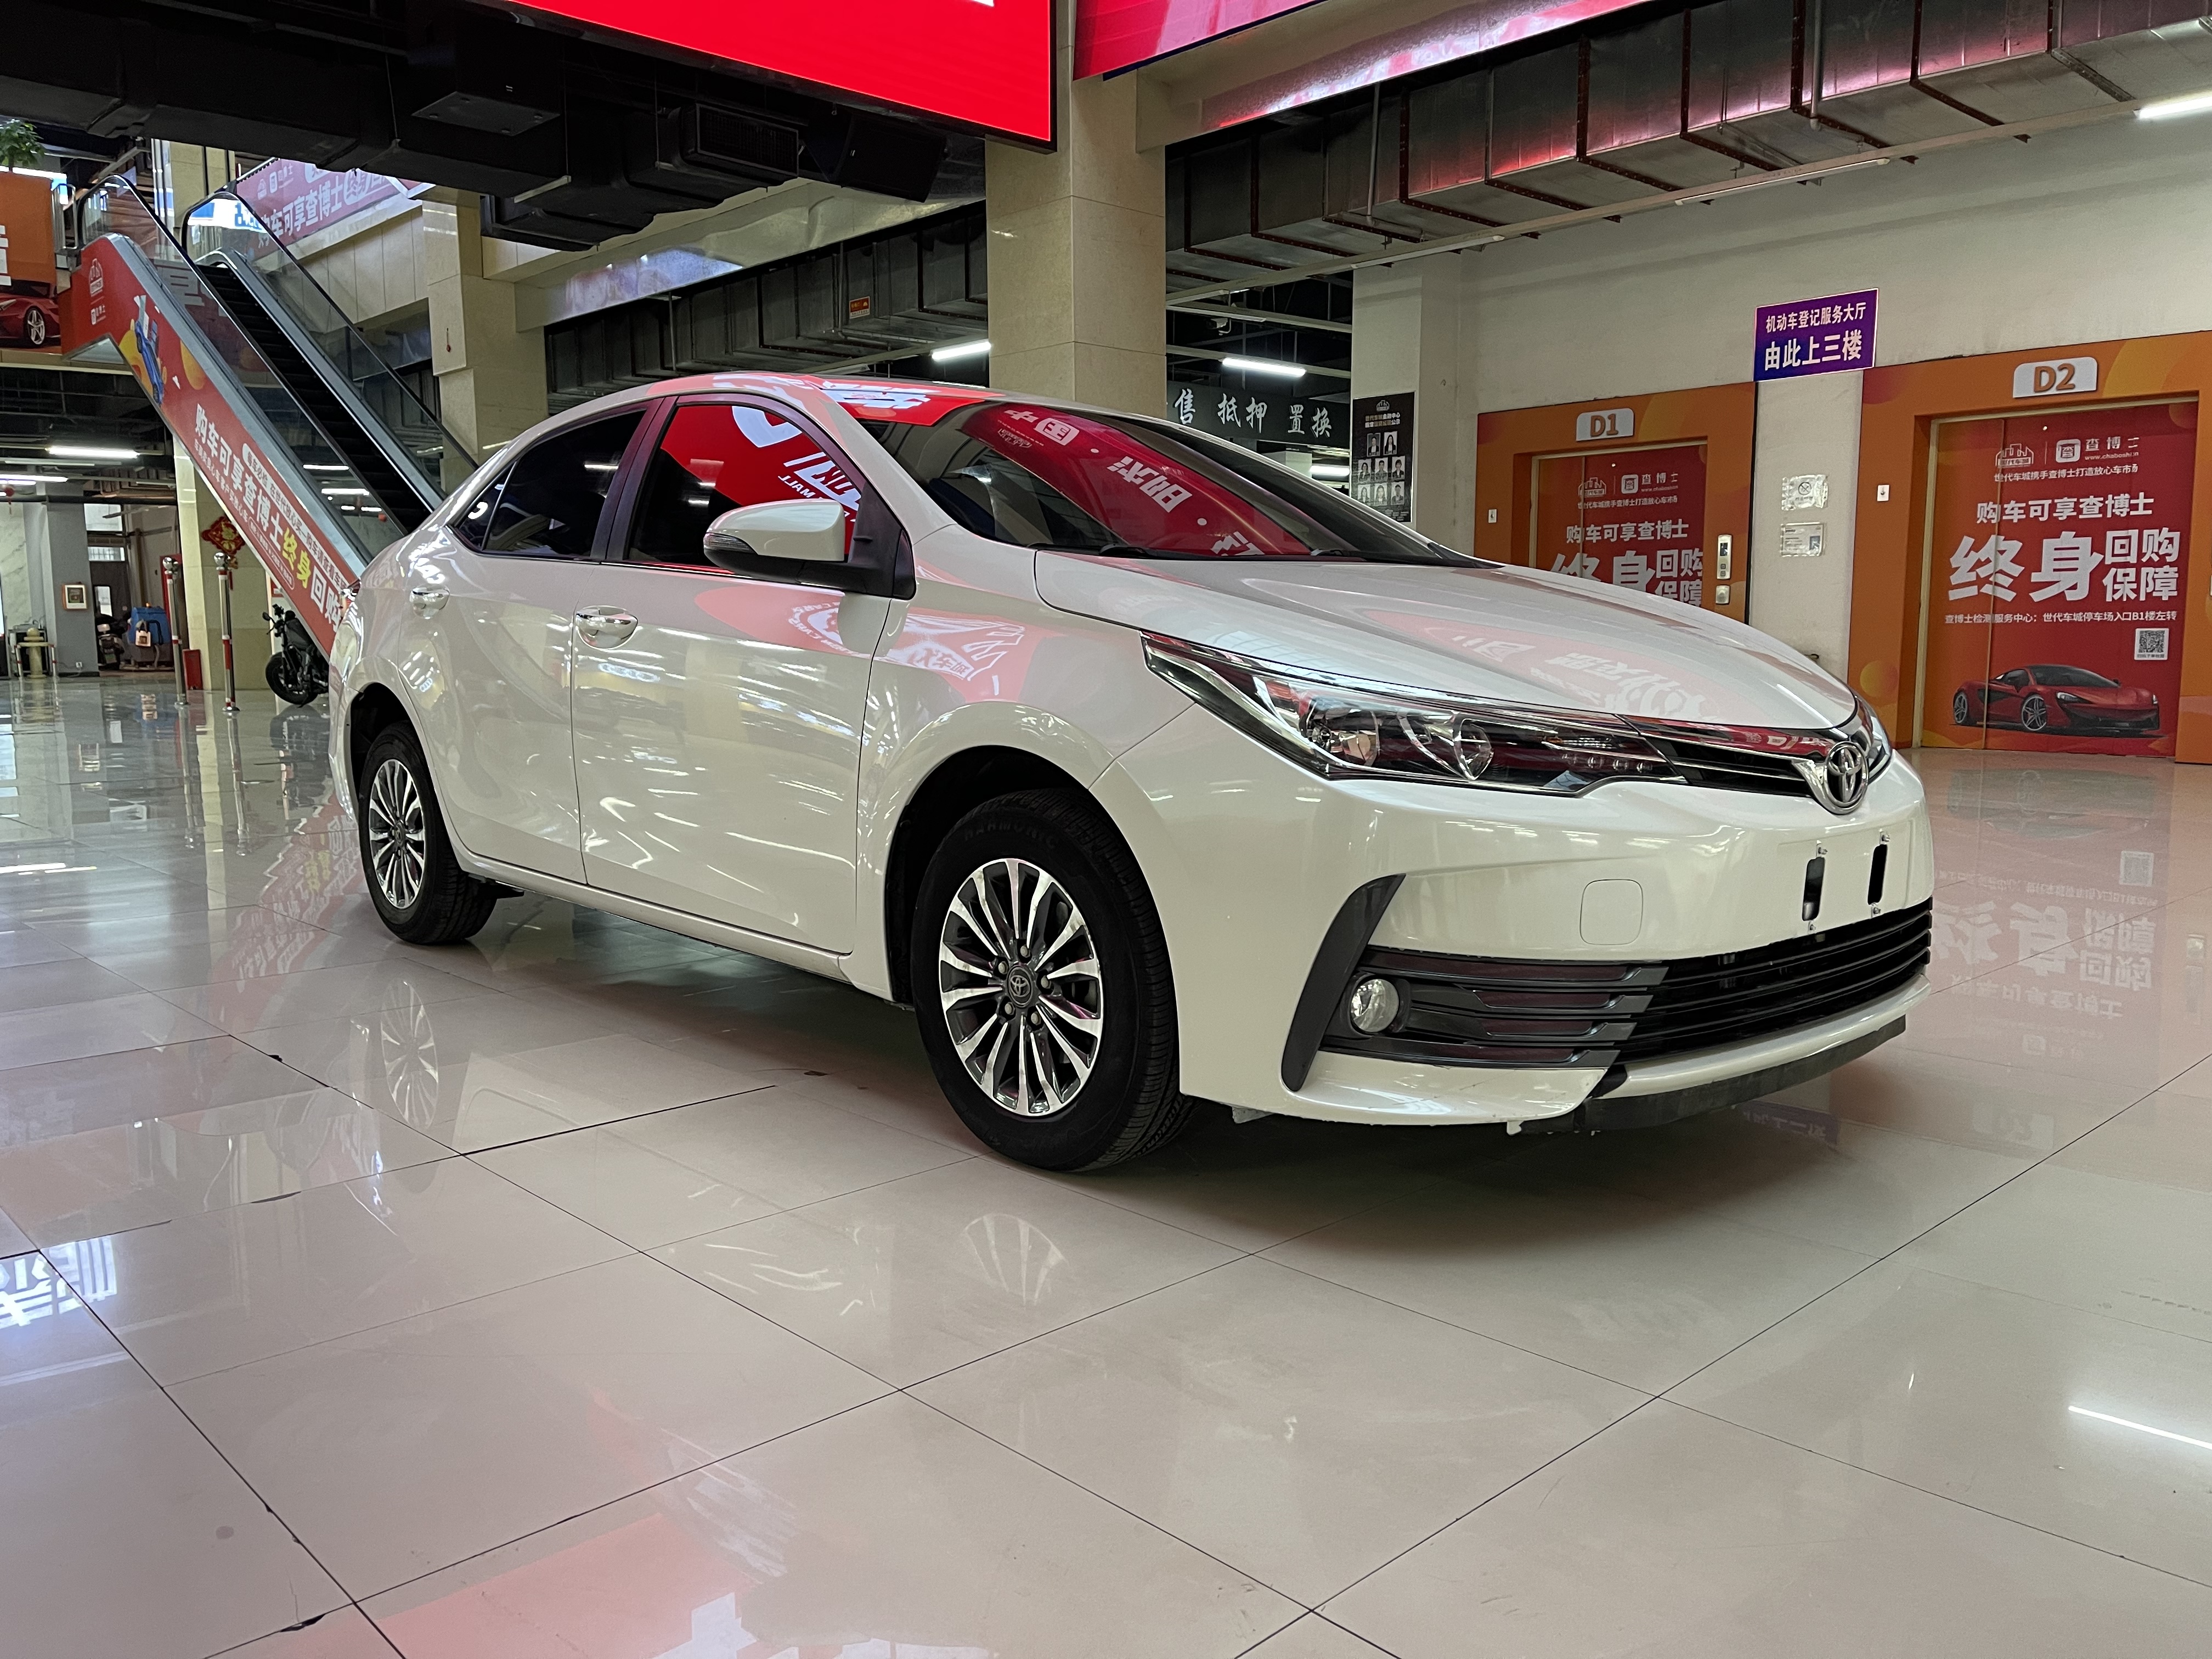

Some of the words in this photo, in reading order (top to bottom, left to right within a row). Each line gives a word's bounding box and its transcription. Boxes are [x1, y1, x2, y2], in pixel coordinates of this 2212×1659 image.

[1765, 302, 1866, 333] 机动车登记服务大厅
[1764, 329, 1862, 371] 由此上三楼
[2034, 363, 2075, 393] D2
[1175, 388, 1196, 425] 售
[1217, 393, 1267, 433] 抵押
[1288, 404, 1332, 438] 置换
[1590, 413, 1619, 437] D1
[1976, 492, 2154, 523] 购车可享查博士
[1566, 518, 1689, 544] 购车可享查博士
[2104, 527, 2181, 565] 回购
[1655, 548, 1703, 578] 回购
[1948, 531, 2104, 602] 终身
[1654, 579, 1702, 607] 保障
[2102, 565, 2179, 602] 保障
